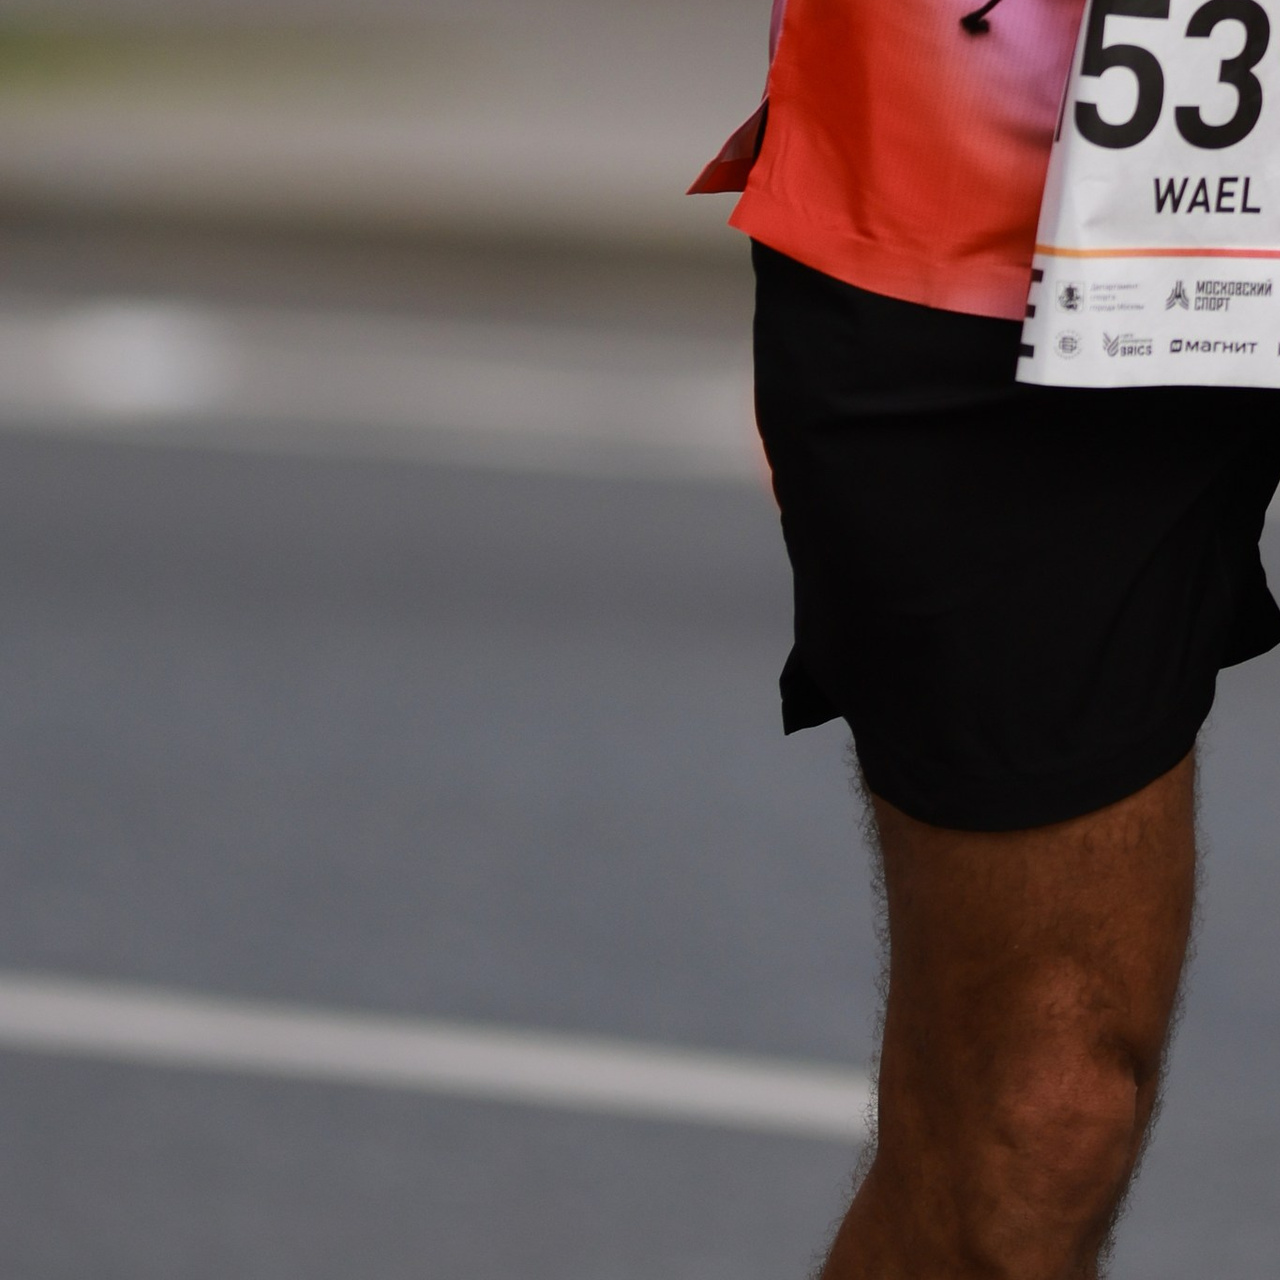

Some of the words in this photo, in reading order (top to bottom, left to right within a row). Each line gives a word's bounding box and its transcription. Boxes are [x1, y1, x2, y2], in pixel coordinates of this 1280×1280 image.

[1153, 177, 1261, 214] WAEL
[1194, 279, 1273, 297] МОСКОВСКИЙ
[1194, 297, 1230, 311] СПОРТ
[1120, 345, 1152, 357] BRICS
[1185, 340, 1258, 355] магнит
